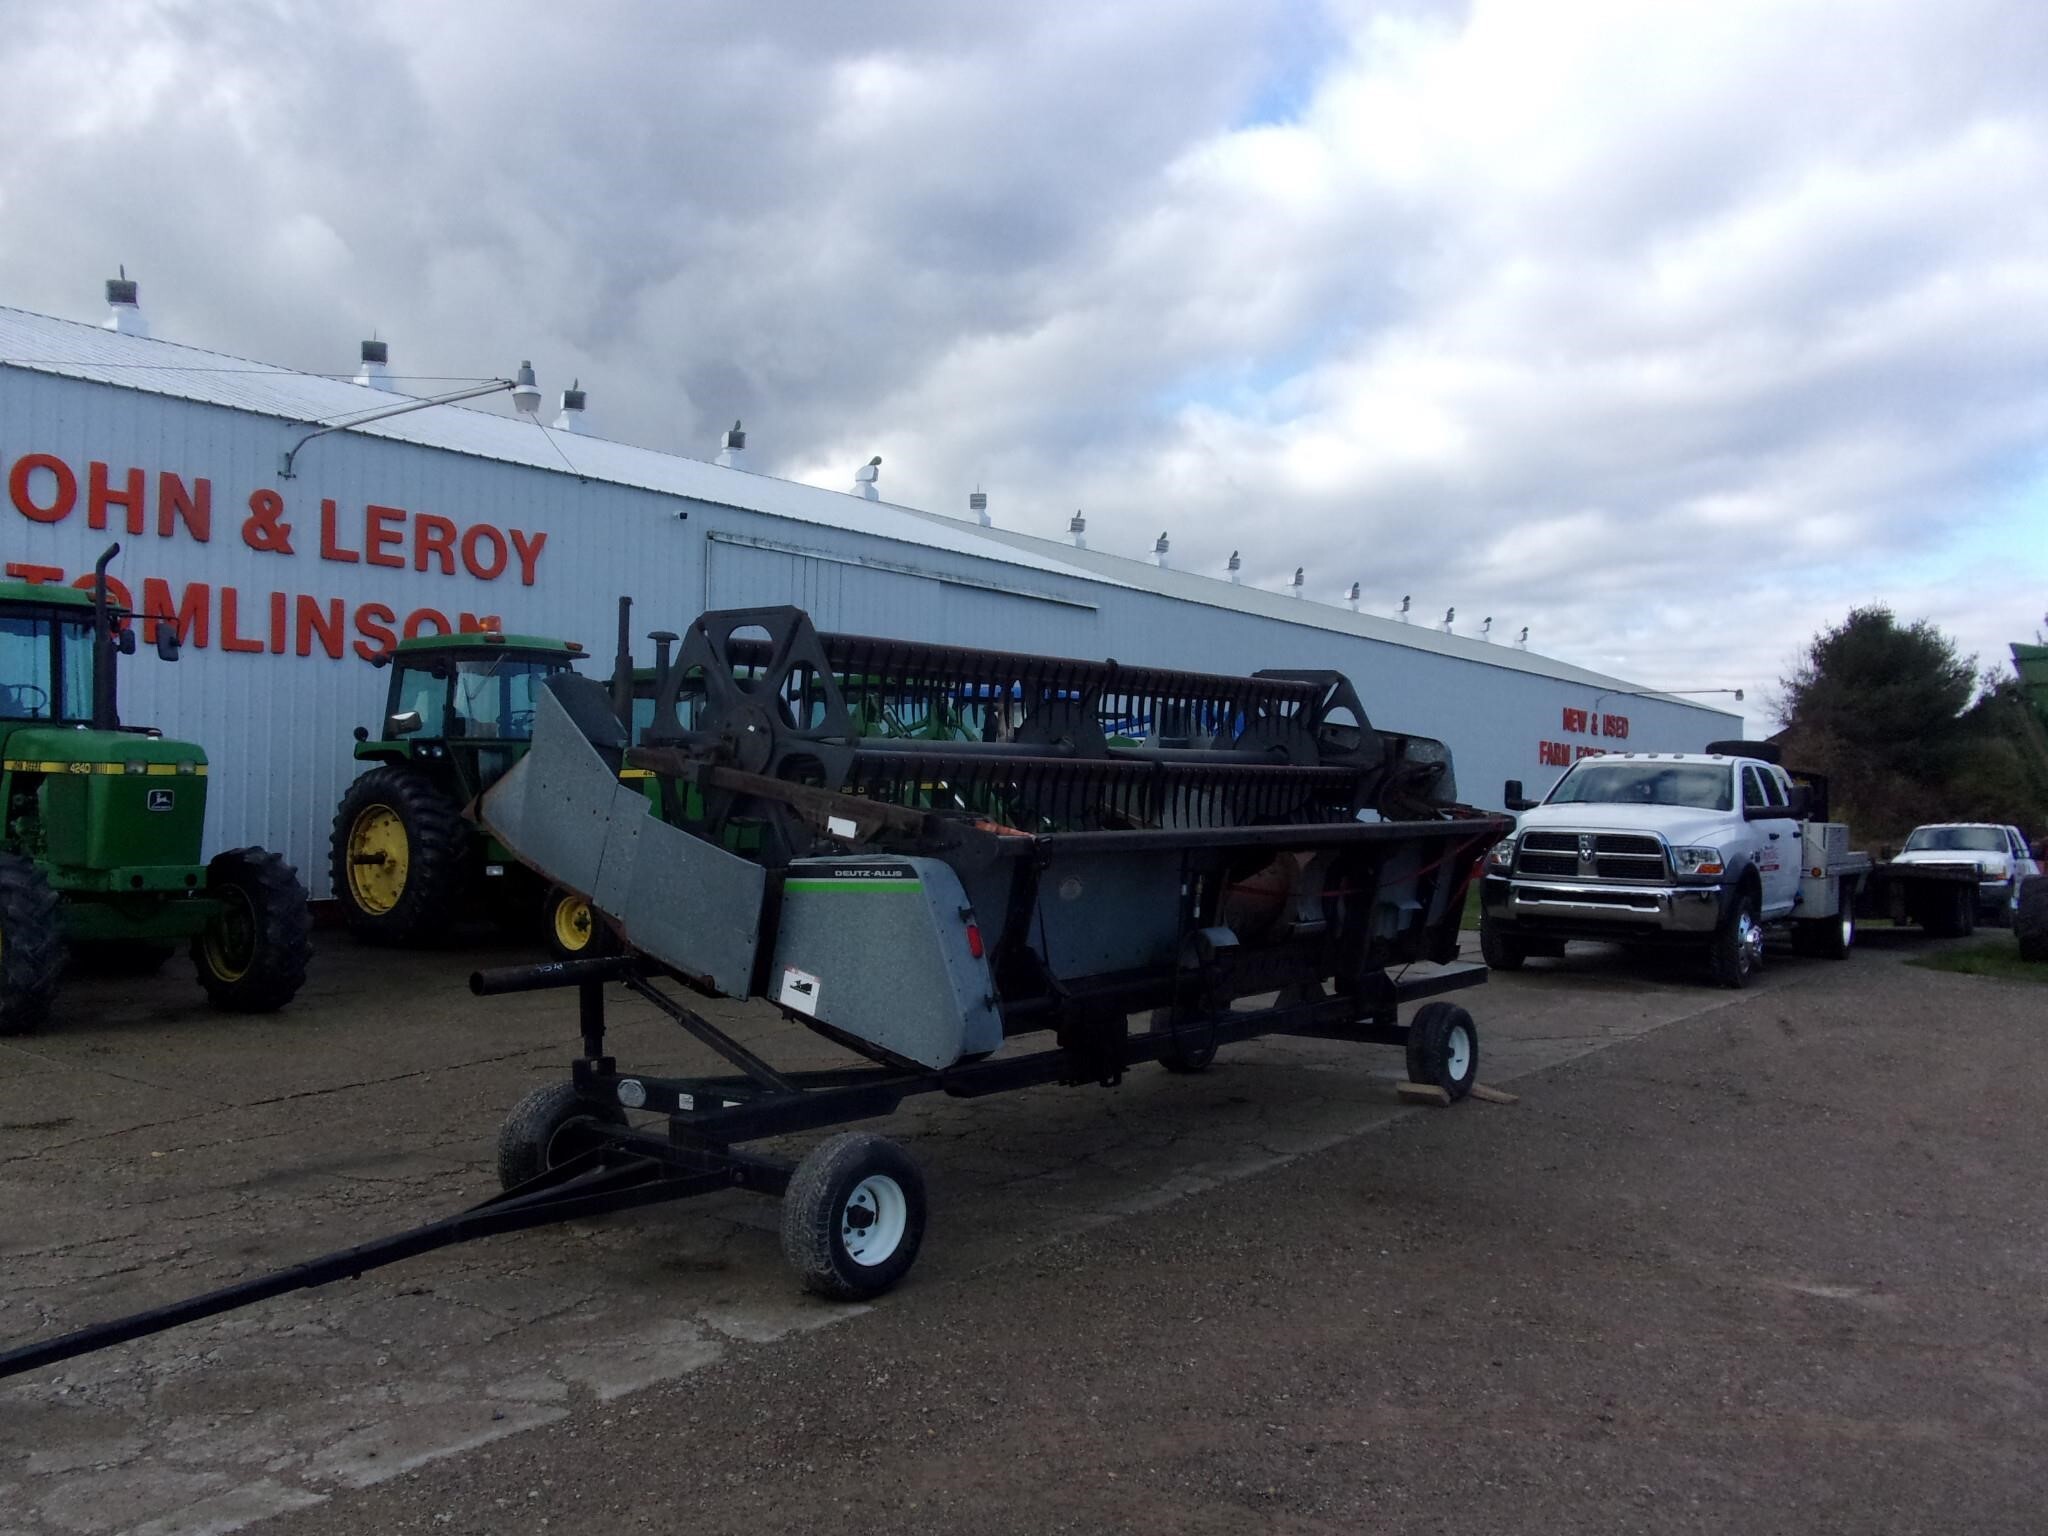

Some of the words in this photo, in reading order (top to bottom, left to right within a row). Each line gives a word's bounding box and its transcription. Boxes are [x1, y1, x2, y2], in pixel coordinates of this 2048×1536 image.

[2, 452, 211, 542] OHN
[242, 489, 295, 555] &
[320, 498, 548, 587] LEROY
[6, 562, 502, 661] MLINS
[1539, 741, 1571, 767] FARM
[1563, 707, 1588, 733] NEW
[1591, 712, 1598, 736] &
[1603, 714, 1629, 739] USED
